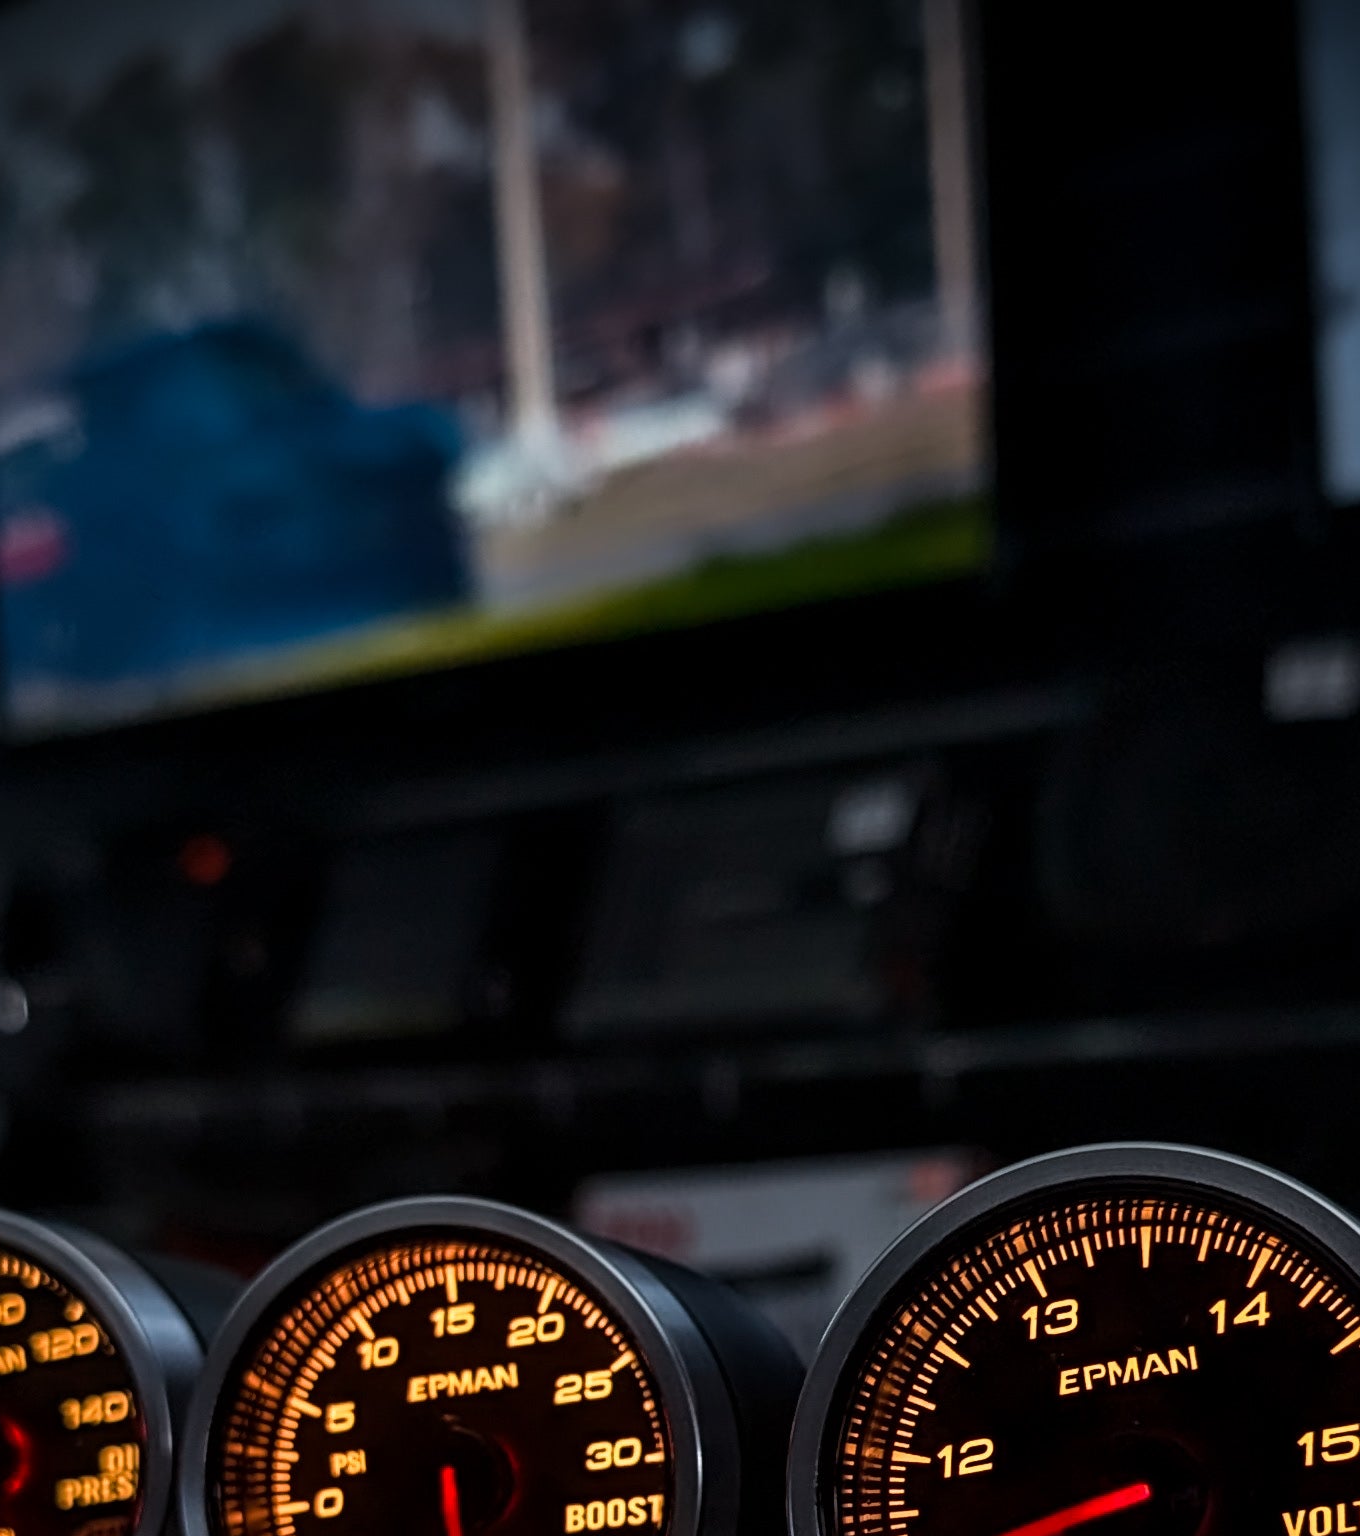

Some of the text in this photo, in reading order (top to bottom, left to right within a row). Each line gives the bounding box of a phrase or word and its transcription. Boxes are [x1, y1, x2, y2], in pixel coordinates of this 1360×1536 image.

[430, 1303, 475, 1337] 15
[507, 1312, 565, 1347] 20
[1022, 1299, 1079, 1340] 13
[1209, 1292, 1271, 1335] 14
[357, 1337, 400, 1369] 10
[407, 1363, 519, 1403] EPMAN
[554, 1370, 613, 1404] 25
[1058, 1346, 1199, 1396] EPMAN
[325, 1401, 356, 1432] 5
[330, 1449, 366, 1476] PSI
[586, 1438, 641, 1471] 30
[937, 1438, 995, 1478] 12
[313, 1488, 344, 1518] 0
[565, 1495, 663, 1533] BOOST
